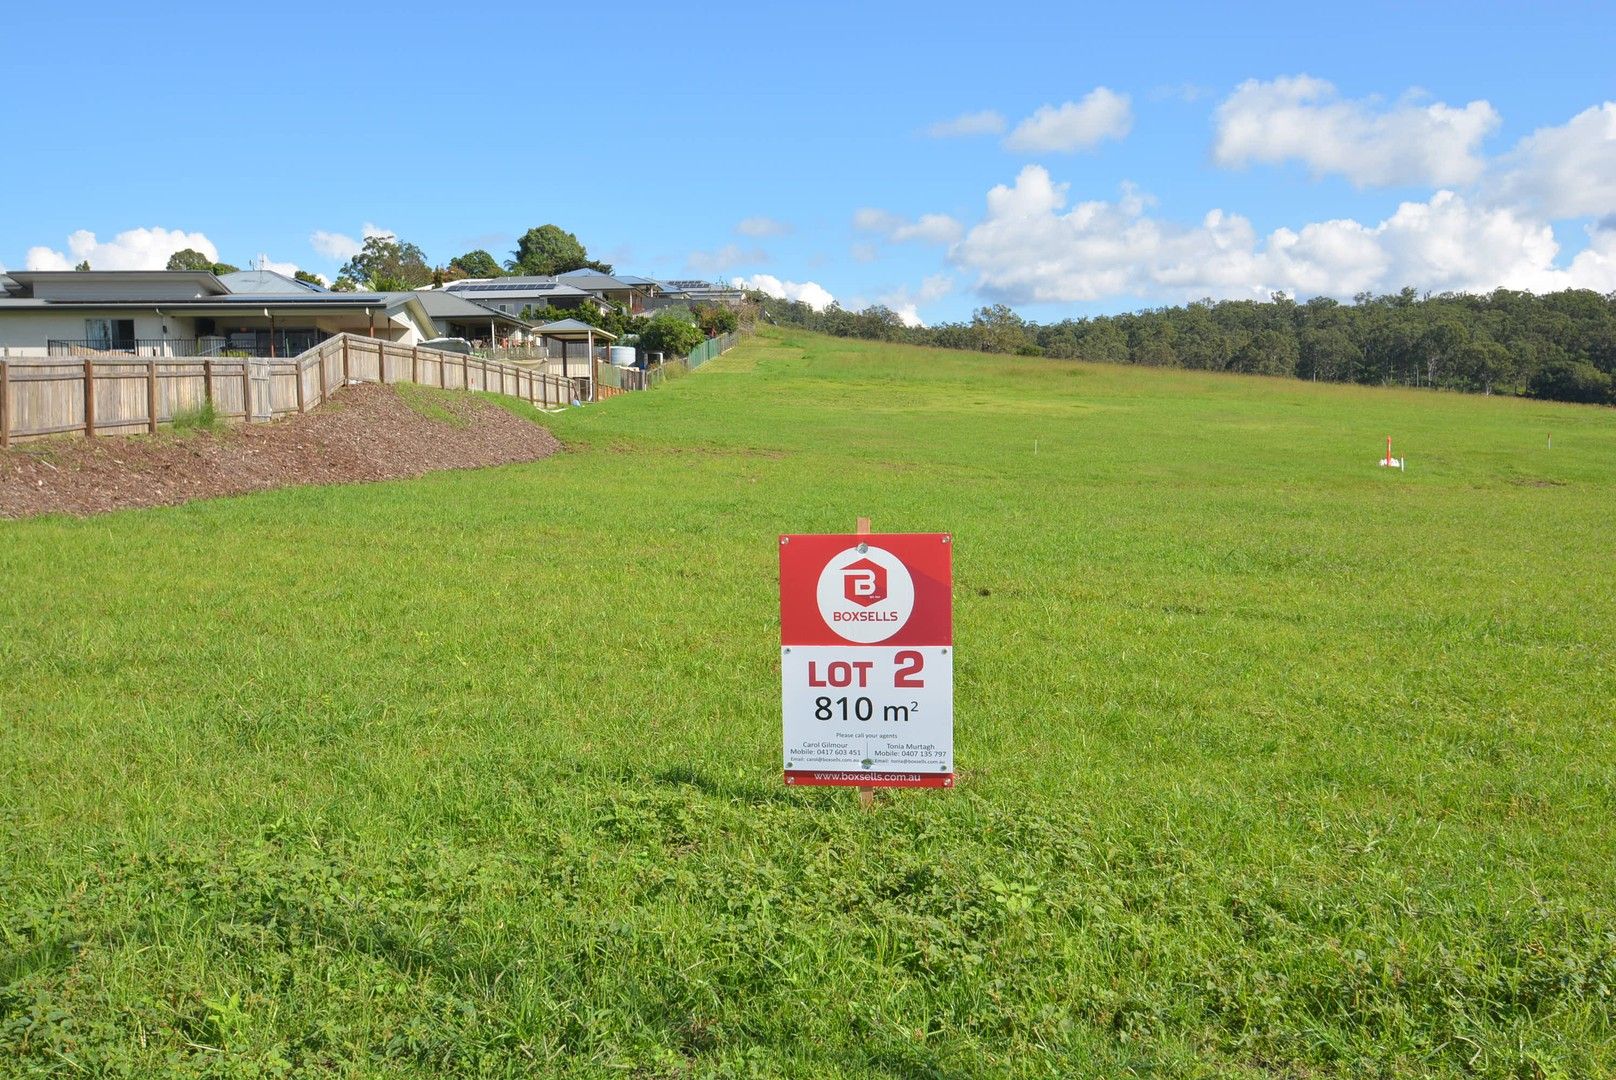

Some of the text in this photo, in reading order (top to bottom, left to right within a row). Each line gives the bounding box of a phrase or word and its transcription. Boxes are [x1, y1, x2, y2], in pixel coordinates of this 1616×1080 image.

[833, 611, 898, 622] BOXSELLS
[808, 650, 924, 688] LOT 2
[814, 696, 873, 721] 810
[906, 743, 935, 751] Murtagh
[814, 772, 921, 782] www.boxsells.com.au
